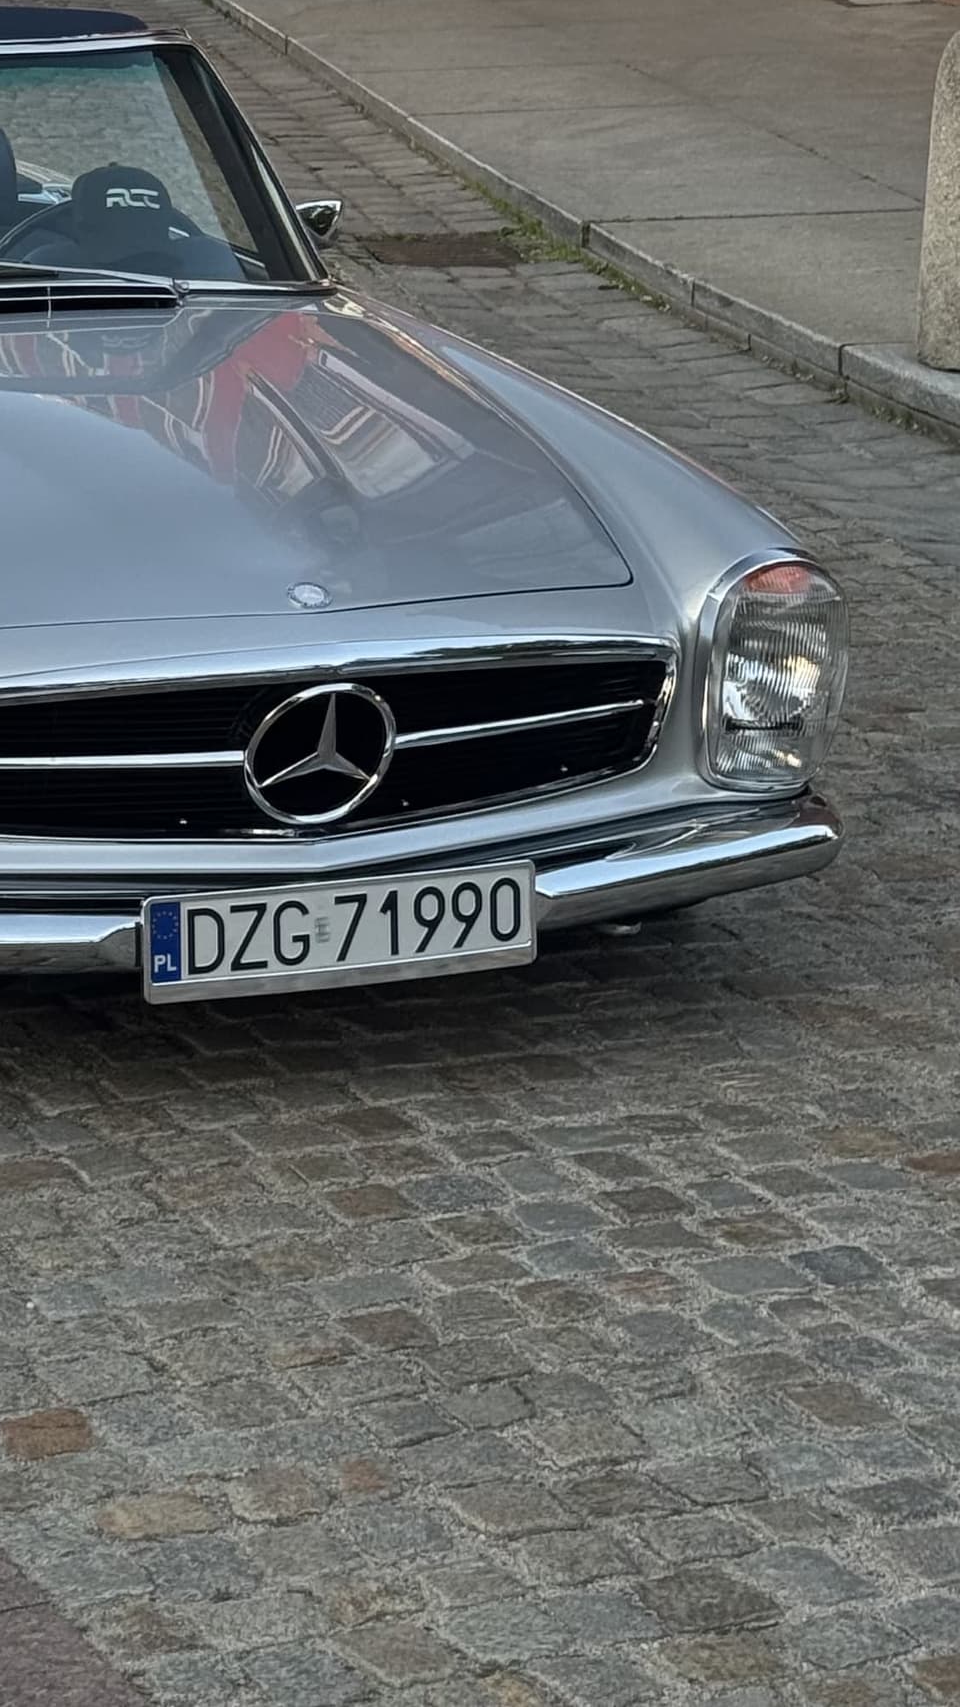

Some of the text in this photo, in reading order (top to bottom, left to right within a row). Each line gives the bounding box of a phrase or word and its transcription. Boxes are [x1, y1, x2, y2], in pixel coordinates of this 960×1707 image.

[153, 877, 521, 975] PL DZG 71990
